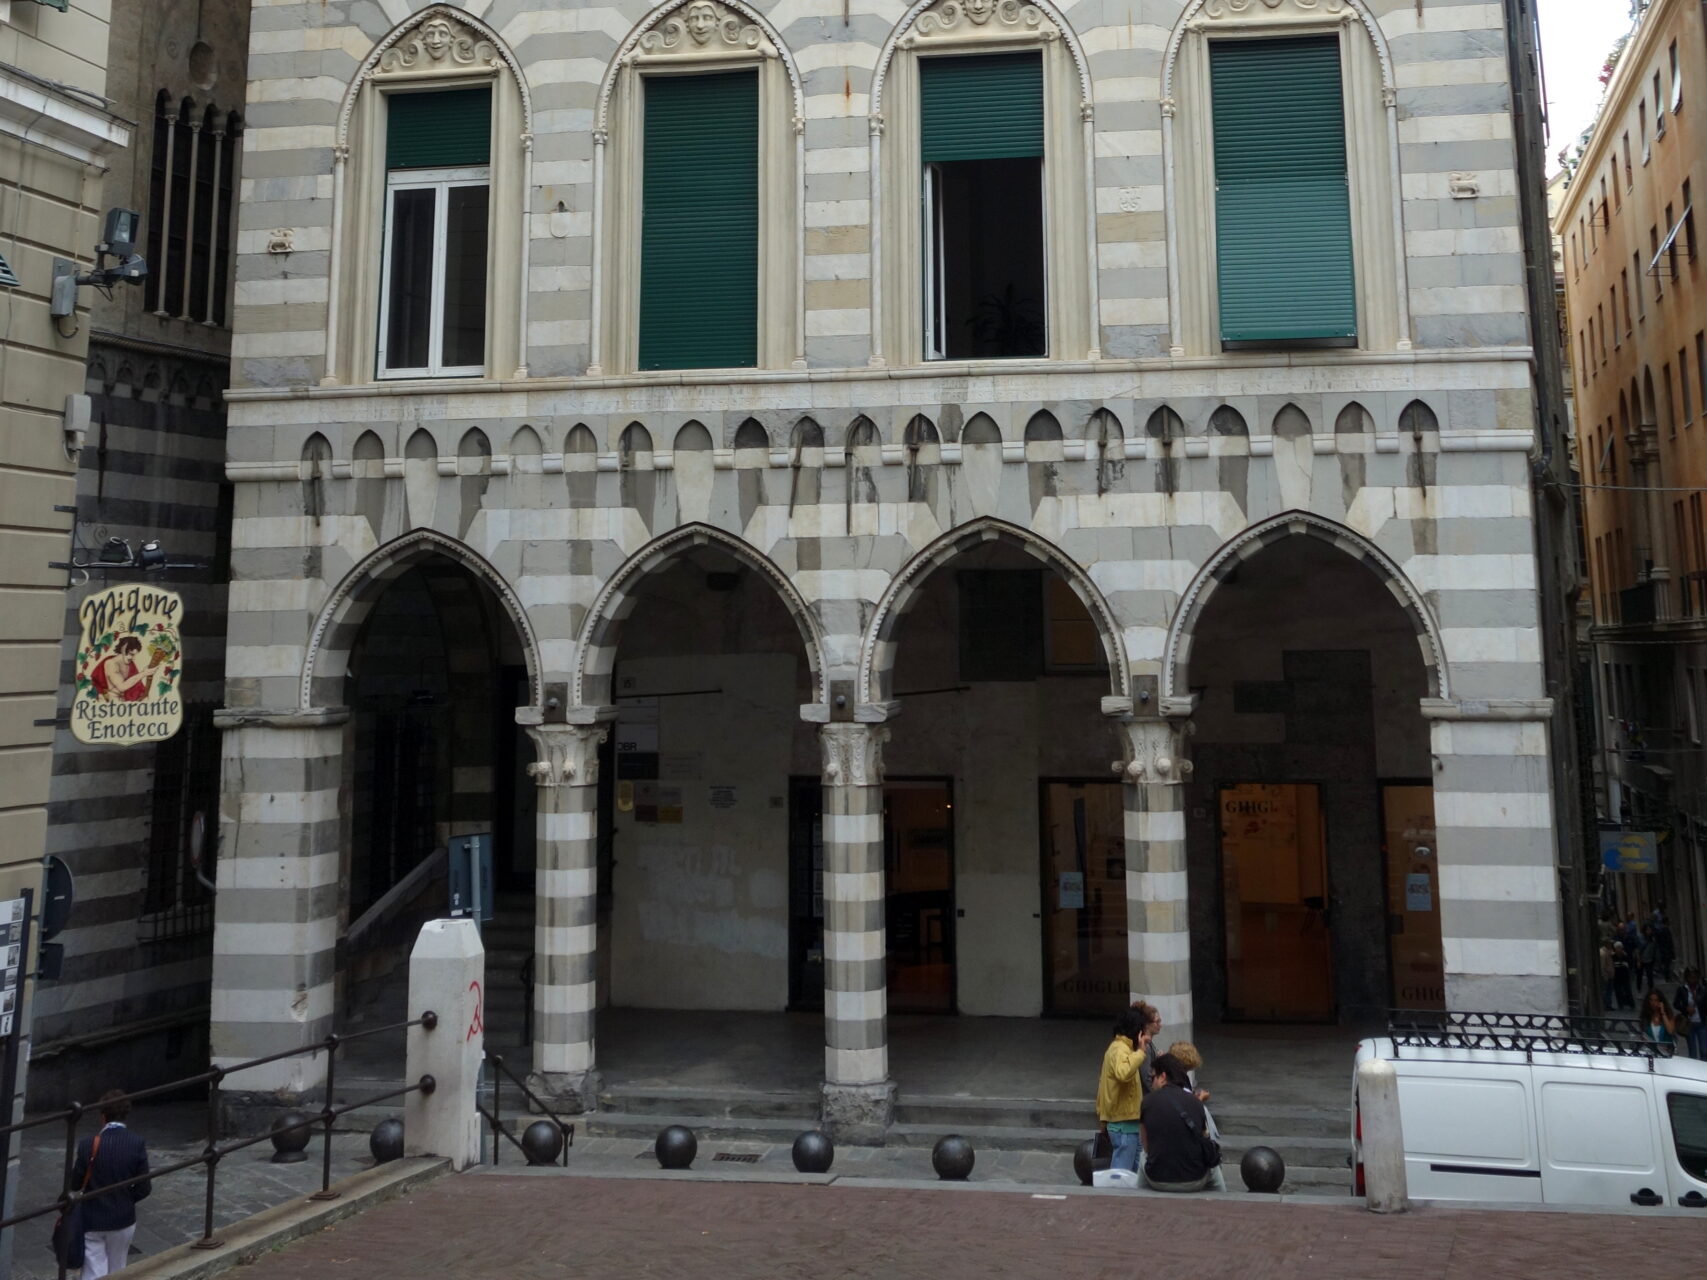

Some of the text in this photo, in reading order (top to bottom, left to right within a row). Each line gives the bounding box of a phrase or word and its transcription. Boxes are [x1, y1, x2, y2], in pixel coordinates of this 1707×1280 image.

[83, 587, 179, 645] Migone
[76, 698, 179, 721] Ristorante
[88, 719, 169, 740] Enoteca
